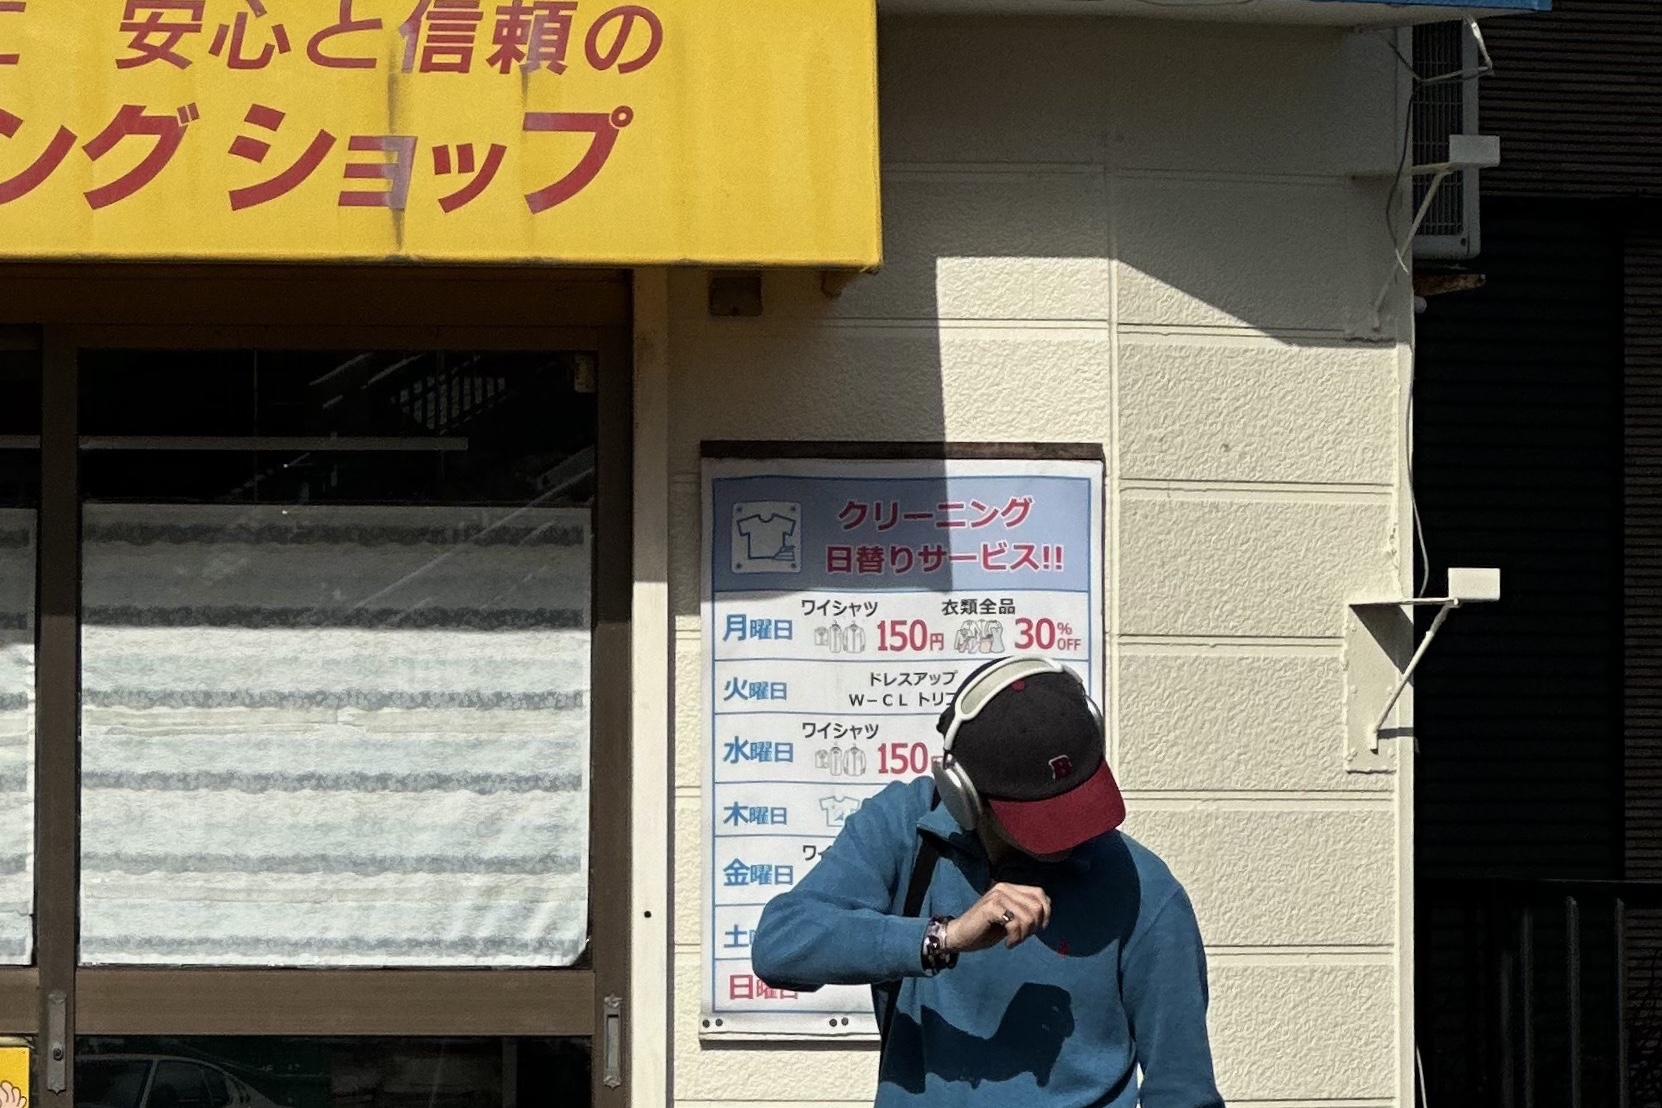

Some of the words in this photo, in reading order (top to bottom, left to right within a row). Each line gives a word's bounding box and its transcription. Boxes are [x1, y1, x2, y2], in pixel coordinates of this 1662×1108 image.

[116, 0, 664, 76] 安心と信頼の
[838, 496, 1034, 531] クリーニング
[801, 599, 879, 617] ワイシャツ
[941, 598, 1016, 616] 衣類全品
[723, 614, 793, 642] 月曜日
[723, 677, 788, 702] 火曜日
[870, 669, 958, 687] ドレスアップ
[802, 722, 879, 740] ワイシャツ
[723, 736, 794, 764] 水曜日
[877, 742, 945, 775] 150
[723, 801, 788, 826] 木曜日
[723, 858, 794, 886] 金曜日
[723, 924, 756, 949] 土
